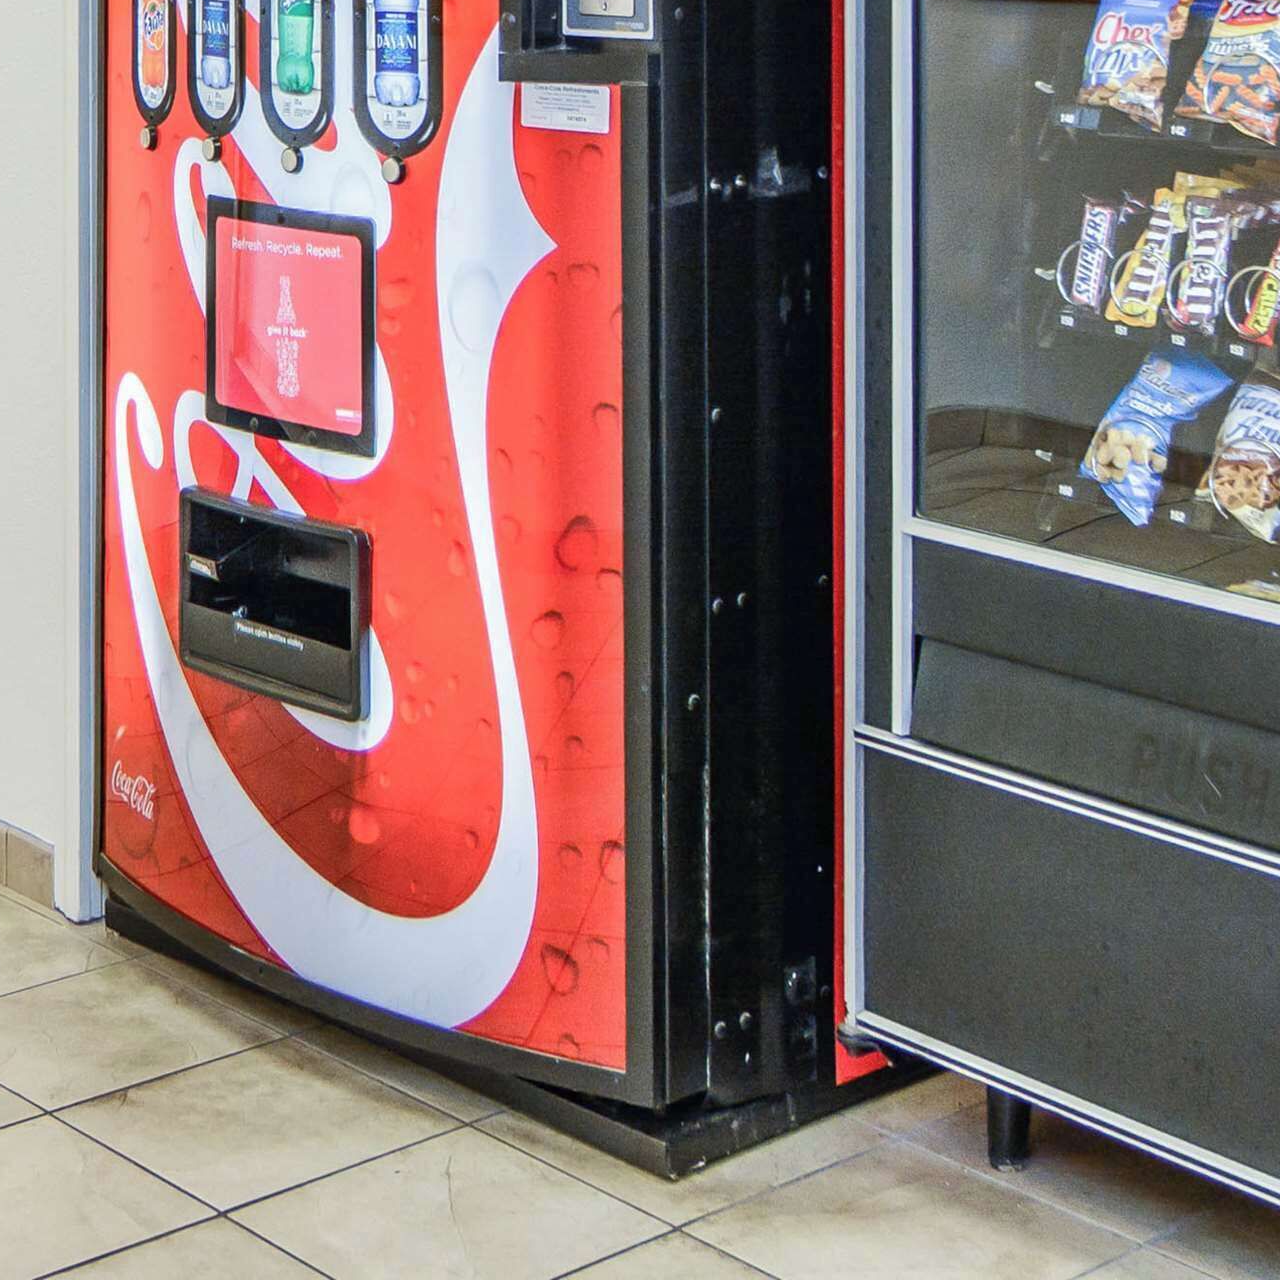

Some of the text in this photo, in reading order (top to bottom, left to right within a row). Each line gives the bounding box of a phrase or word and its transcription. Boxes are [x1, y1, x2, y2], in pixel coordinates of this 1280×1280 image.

[376, 33, 417, 50] DASANI
[1094, 12, 1163, 46] Chex
[305, 246, 344, 259] Repeat.
[111, 759, 156, 820] Coca-Cola
